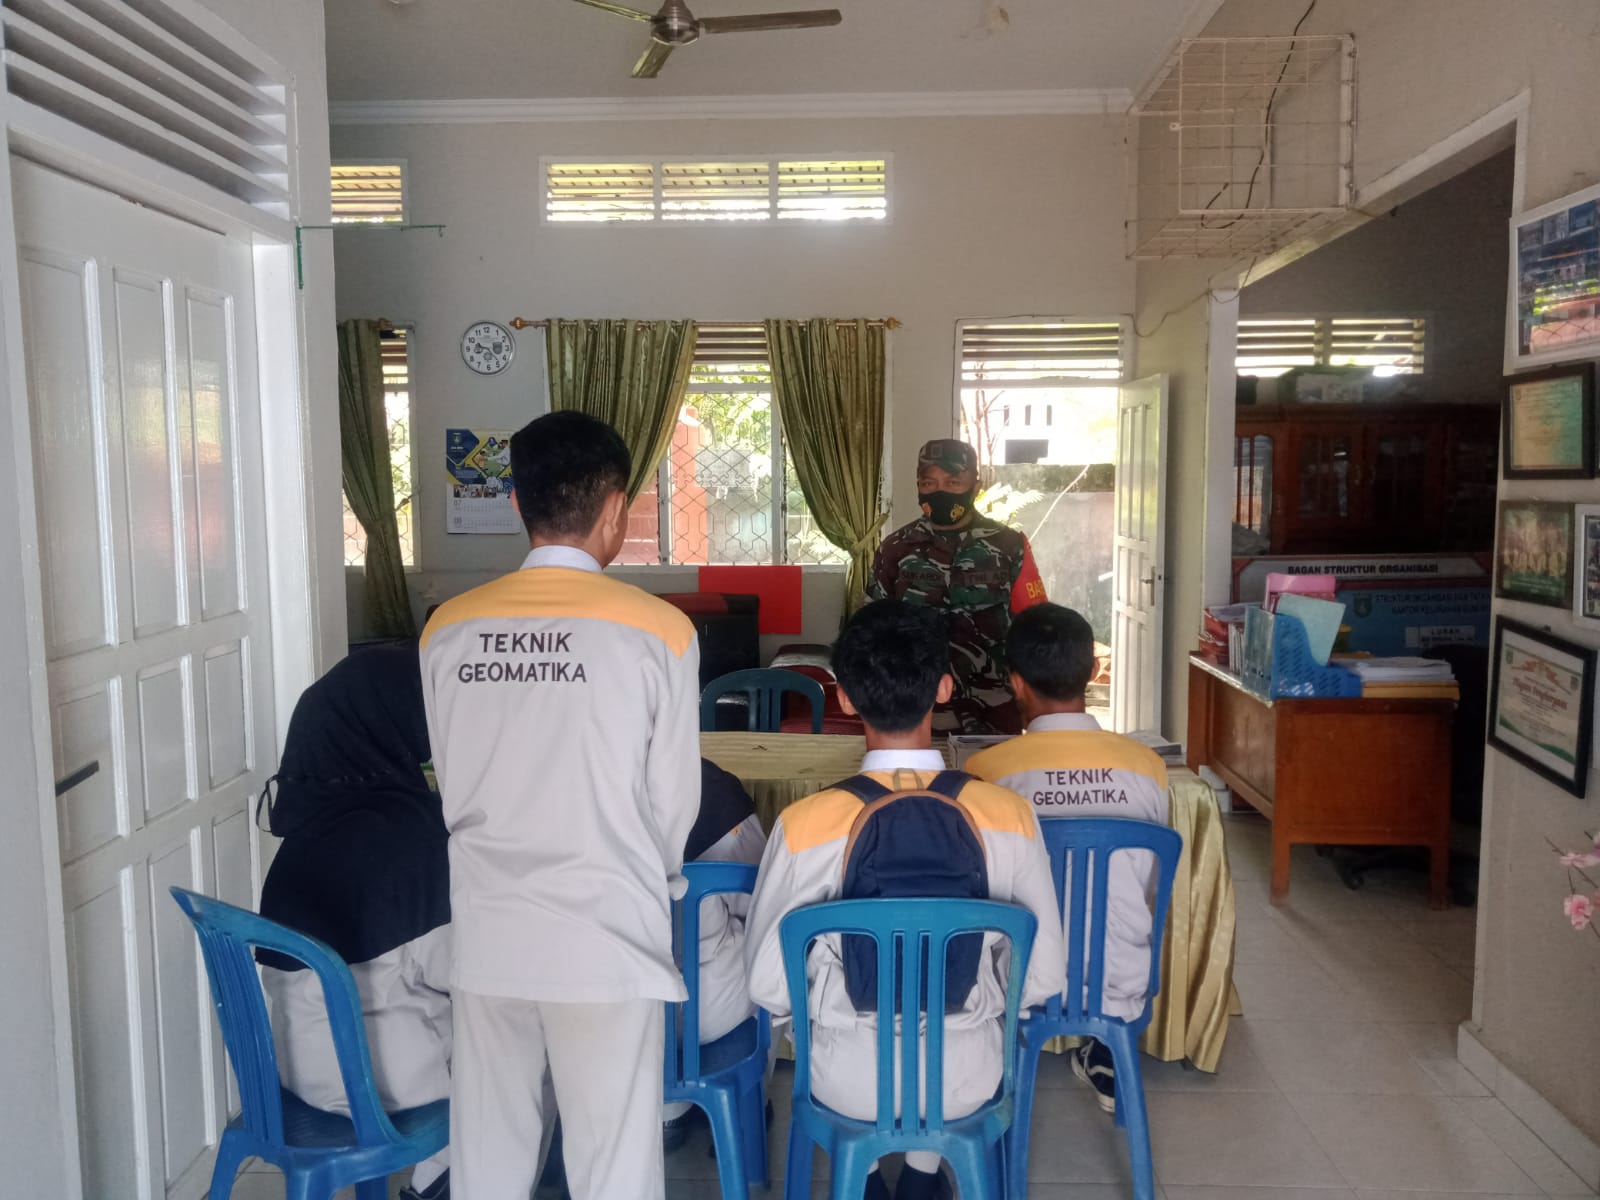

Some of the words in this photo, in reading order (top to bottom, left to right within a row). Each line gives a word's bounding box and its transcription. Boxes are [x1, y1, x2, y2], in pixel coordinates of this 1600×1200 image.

[1288, 565, 1321, 575] BAGAN
[1324, 564, 1376, 574] STRUKTUR
[1378, 563, 1439, 574] ORGANISASI
[479, 632, 573, 653] TEKNIK
[458, 661, 587, 683] GEOMATIKA
[1044, 768, 1114, 786] TEKNIK
[1033, 788, 1129, 806] GEOMATIKA
